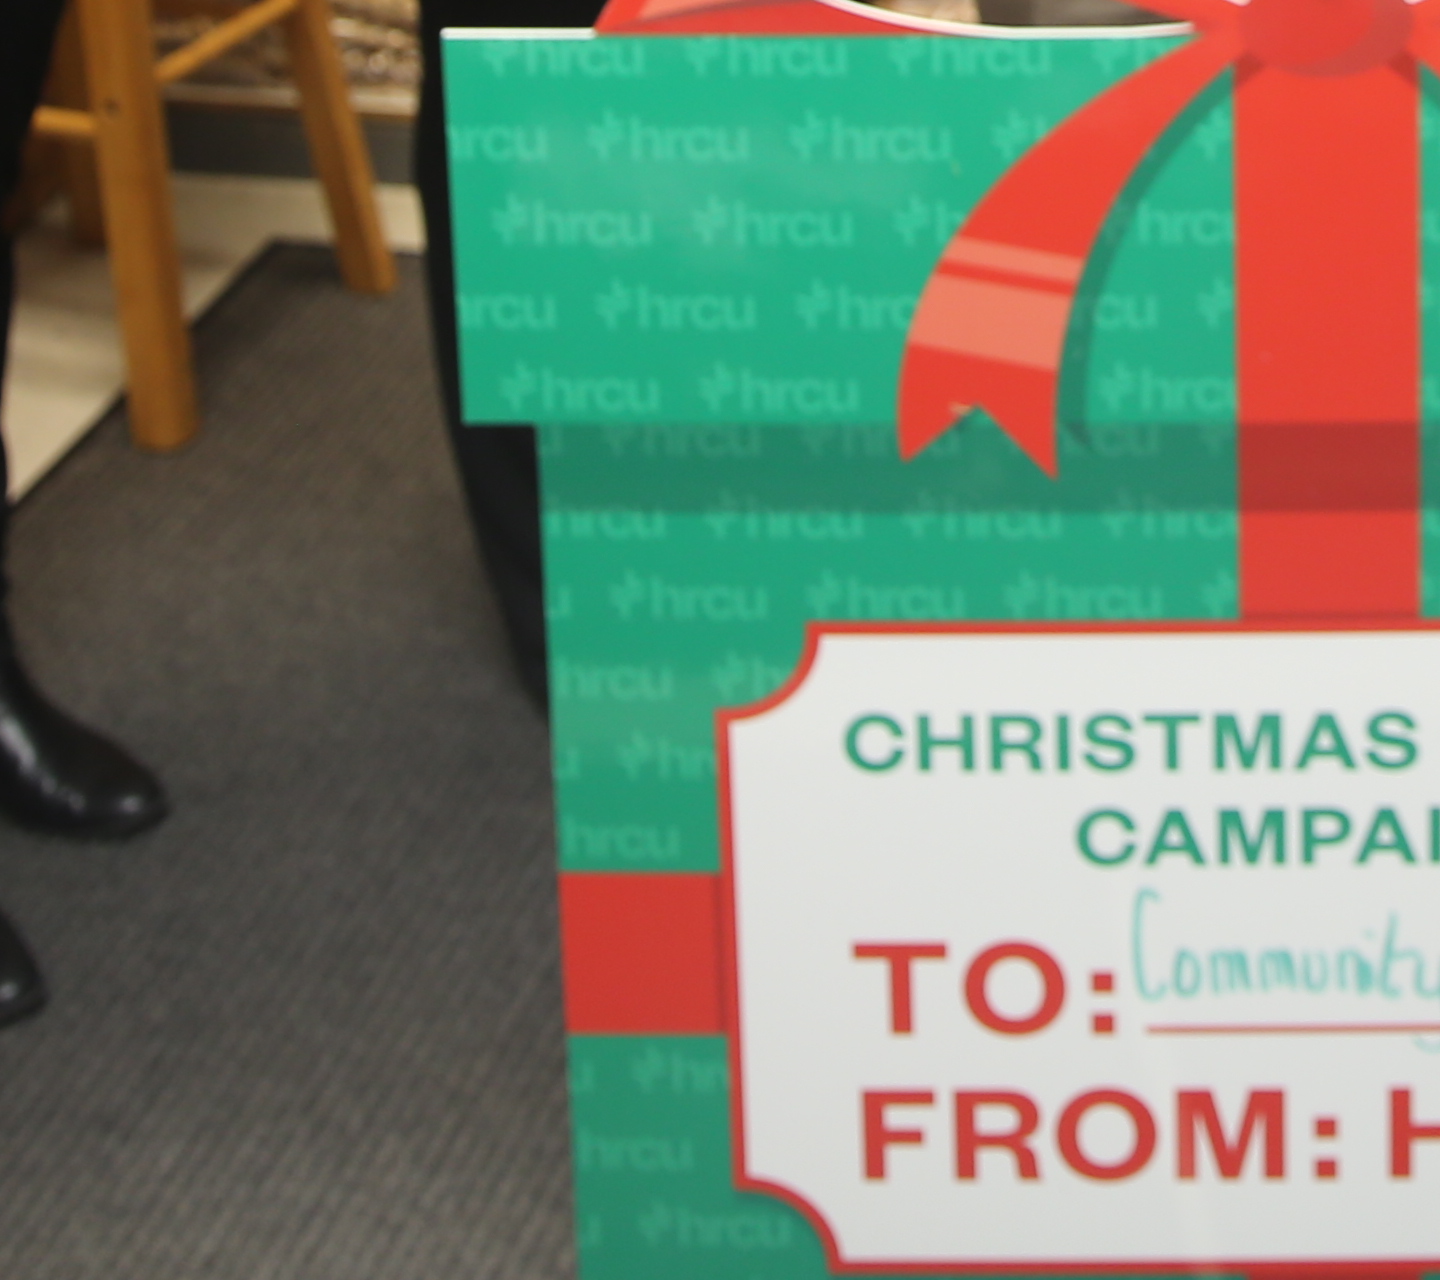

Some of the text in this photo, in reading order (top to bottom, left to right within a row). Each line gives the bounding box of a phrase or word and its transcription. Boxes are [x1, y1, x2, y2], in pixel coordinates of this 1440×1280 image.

[629, 116, 752, 163] hrcu
[831, 116, 953, 162] hrcu
[533, 199, 653, 247] hrcu
[734, 199, 854, 247] hrcu
[637, 284, 759, 331] hrcu
[541, 366, 660, 415] hrcu
[739, 366, 860, 415] hrcu
[651, 574, 769, 622] hrcu
[843, 709, 1421, 774] CHRISTMAS
[851, 940, 1119, 1038] TO:
[860, 1086, 1342, 1183] FROM:
